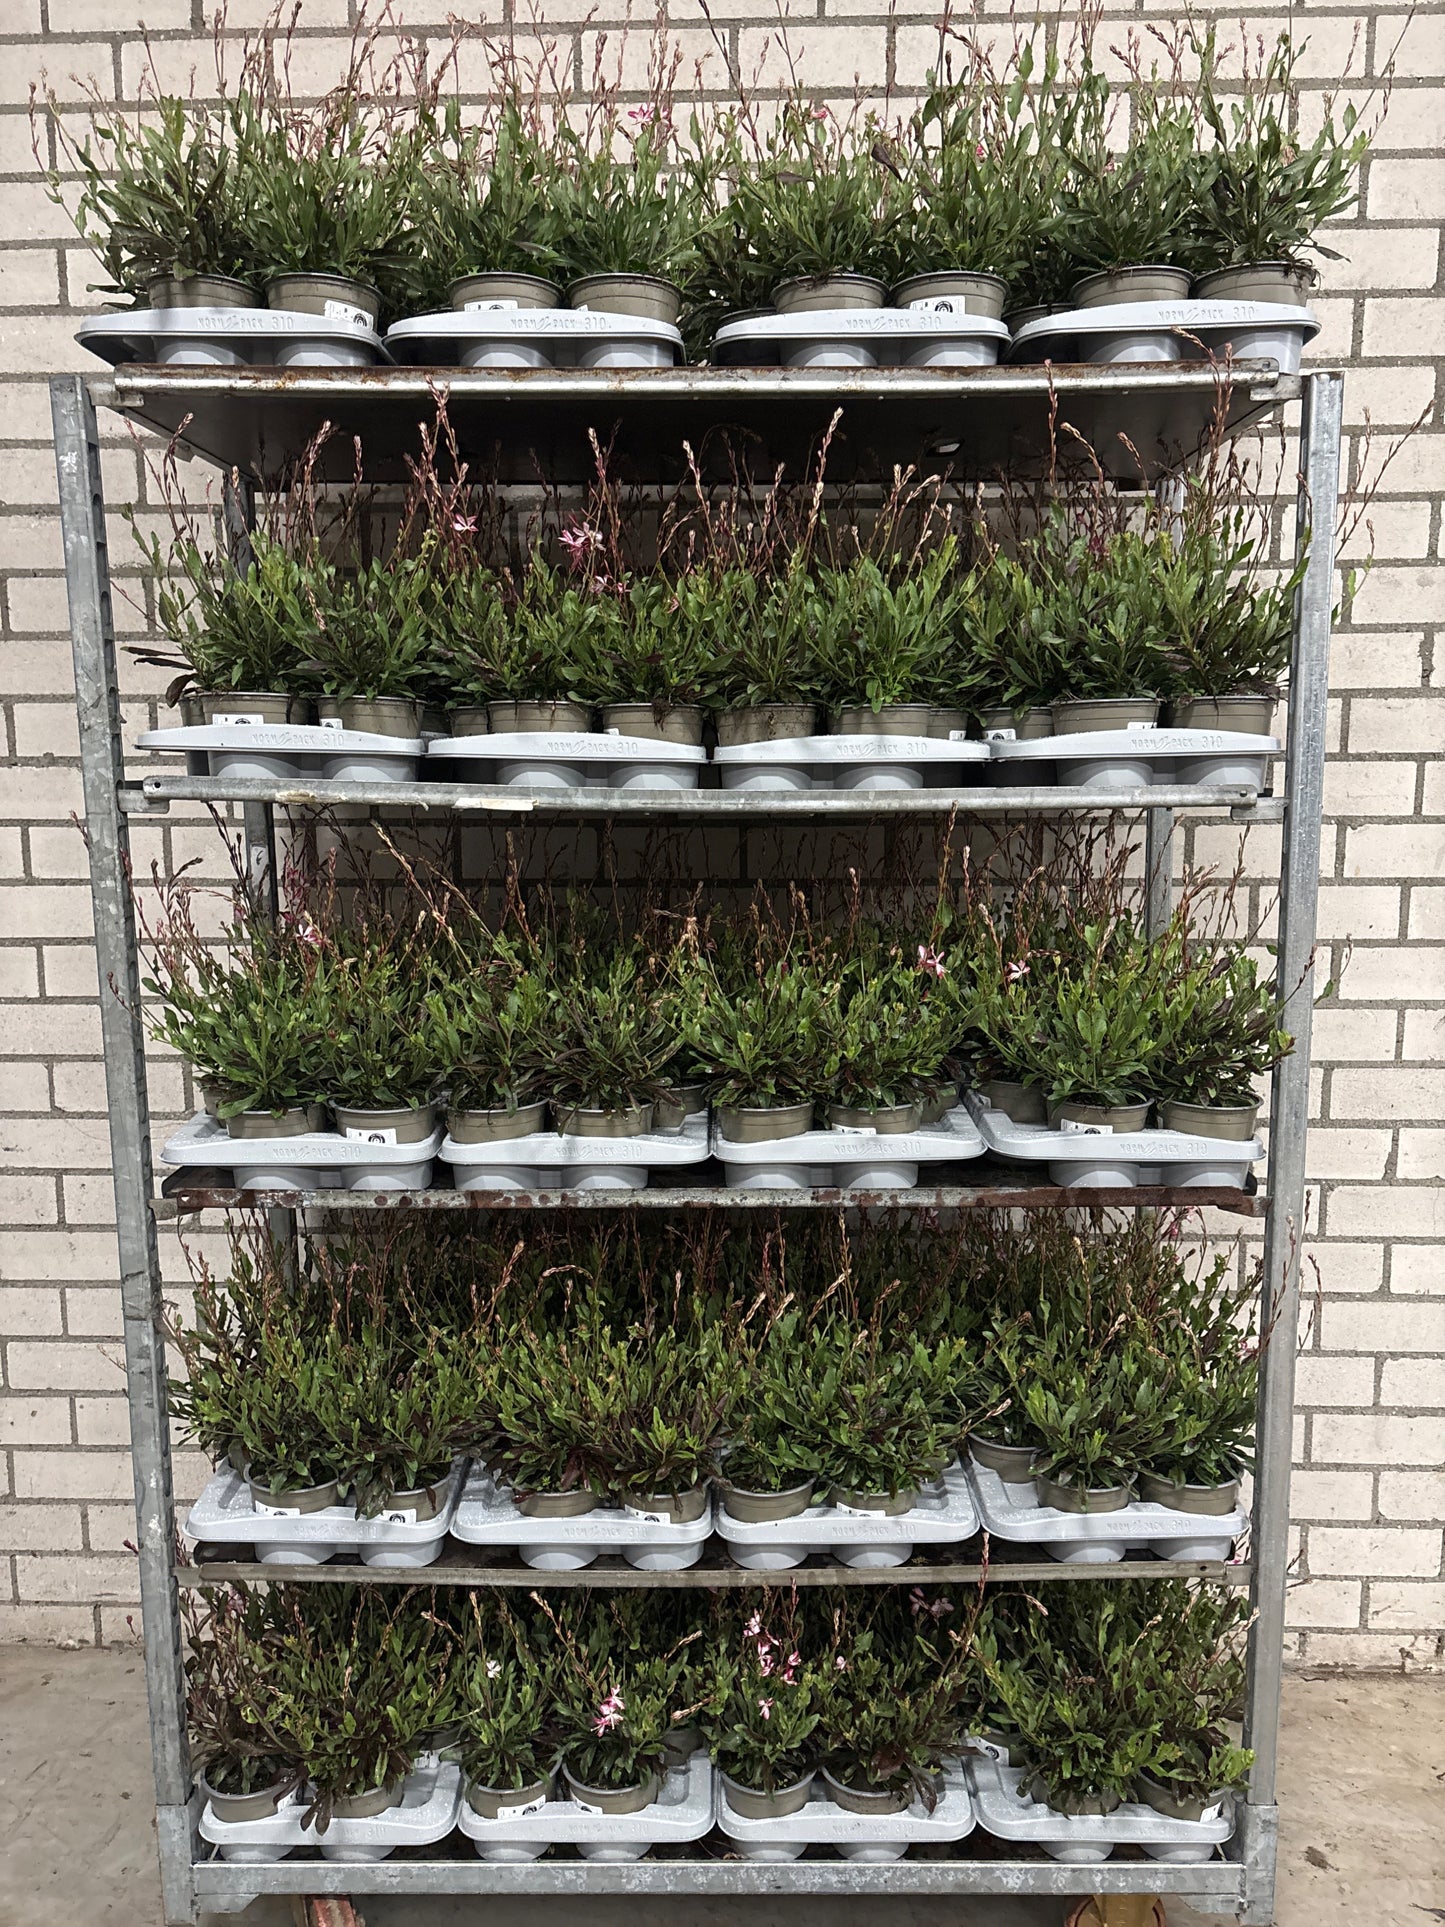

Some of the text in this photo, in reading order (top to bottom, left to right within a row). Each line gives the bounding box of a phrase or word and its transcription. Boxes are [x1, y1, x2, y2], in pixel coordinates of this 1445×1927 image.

[1159, 306, 1255, 321] NORM PACK 310
[198, 316, 294, 330] NORM PACK 310
[511, 317, 606, 330] NORM PACK 310
[846, 316, 942, 330] NORM PACK 310
[252, 734, 344, 746] NORM PACK 310
[1131, 736, 1223, 749] NORM PACK 310
[548, 742, 638, 754] NORM PACK 310
[837, 743, 928, 755] NORM PACK 310
[340, 1146, 361, 1159] 310
[620, 1145, 642, 1158] 310
[902, 1141, 921, 1153] 310
[1187, 1143, 1208, 1156] 310
[628, 1526, 648, 1538] 310
[896, 1524, 916, 1537] 310
